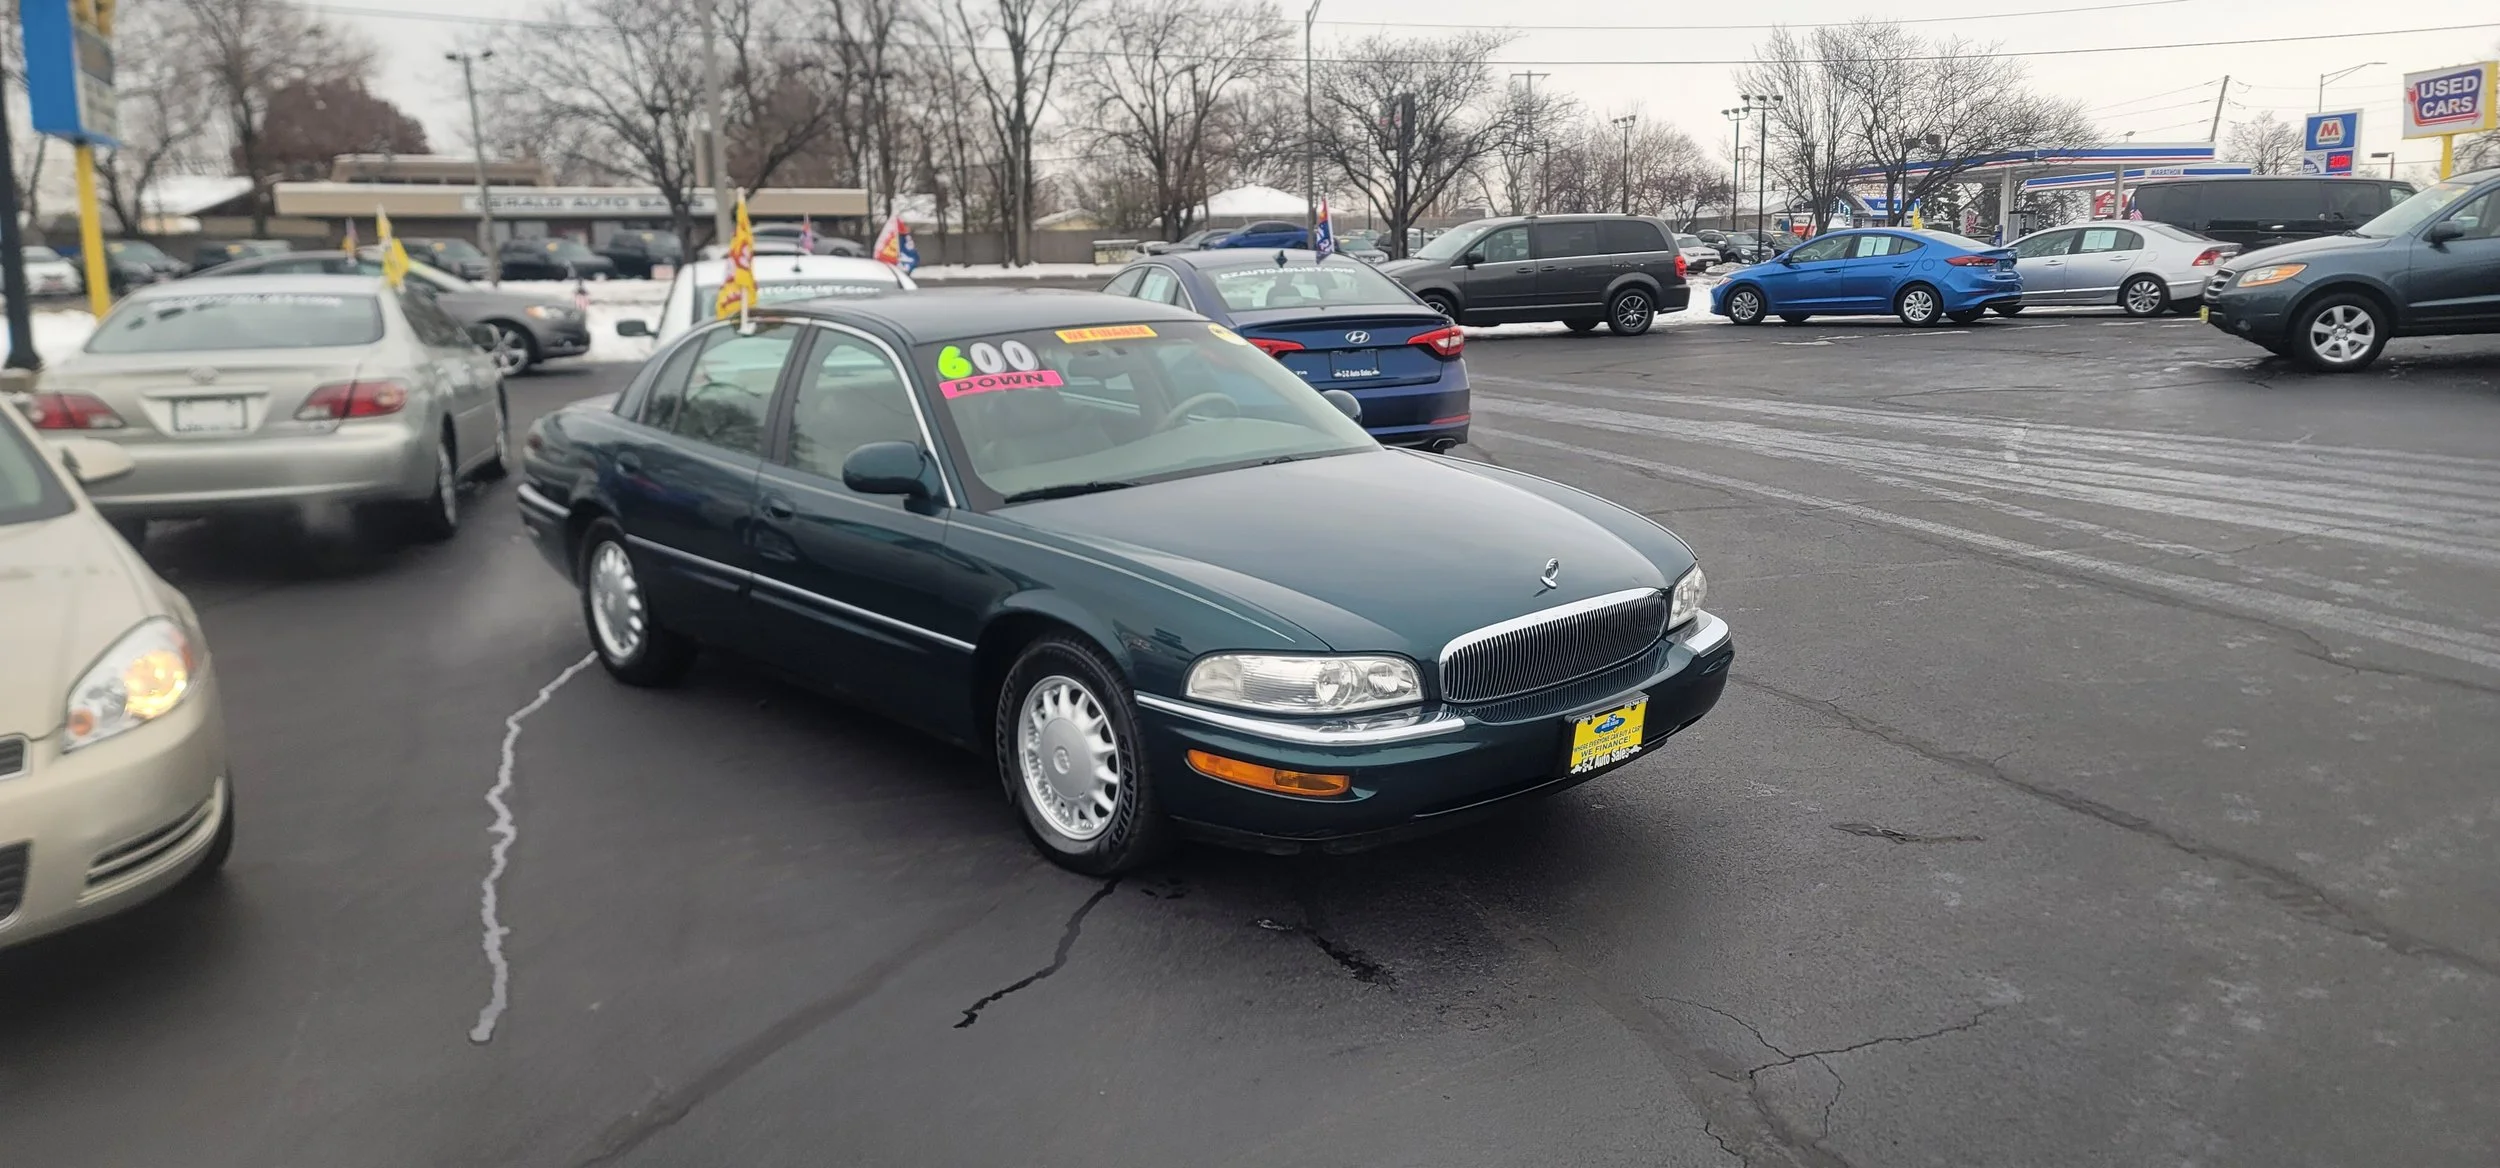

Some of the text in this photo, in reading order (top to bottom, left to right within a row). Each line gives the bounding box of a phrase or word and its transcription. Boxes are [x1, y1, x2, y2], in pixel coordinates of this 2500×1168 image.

[2420, 75, 2478, 98] USED
[2421, 96, 2473, 118] CARS
[2320, 122, 2340, 137] M
[2151, 168, 2181, 176] MARATHON
[573, 197, 630, 208] AUTO
[639, 197, 704, 208] SAS
[937, 339, 1040, 379] 600
[954, 372, 1045, 392] DOWN
[1581, 736, 1631, 758] WE FINANCE!
[1594, 752, 1610, 769] Auto
[1611, 747, 1630, 763] Sales
